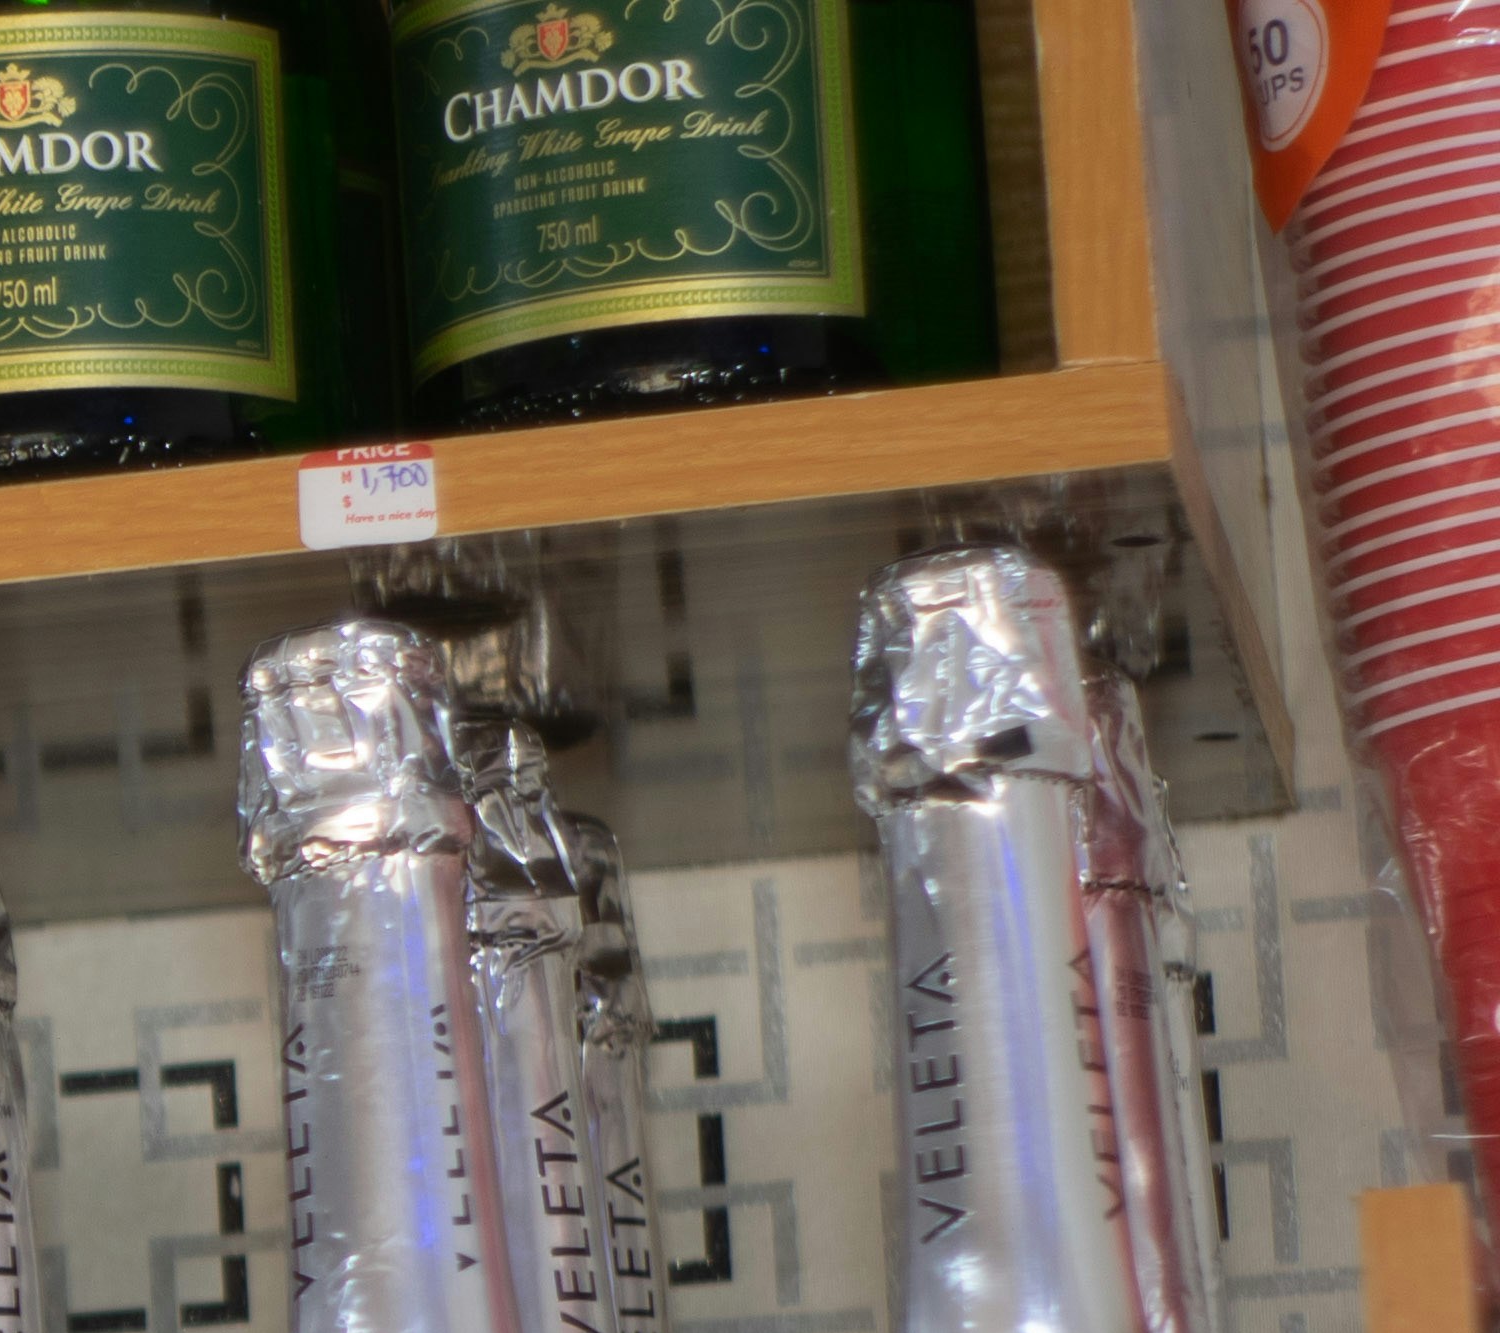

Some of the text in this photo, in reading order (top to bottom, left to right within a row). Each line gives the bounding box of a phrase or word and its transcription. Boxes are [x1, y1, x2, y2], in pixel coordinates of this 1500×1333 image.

[443, 59, 704, 143] CHAMDOR
[513, 159, 616, 192] NON-ALCOHOLIC
[54, 183, 132, 219] Grape
[144, 184, 223, 215] Drink
[34, 276, 57, 306] ml
[337, 444, 411, 461] PRICE
[361, 462, 428, 496] 1,700
[345, 514, 374, 524] Have
[389, 510, 412, 521] nice
[415, 508, 437, 521] day
[908, 951, 971, 1244] VELETA
